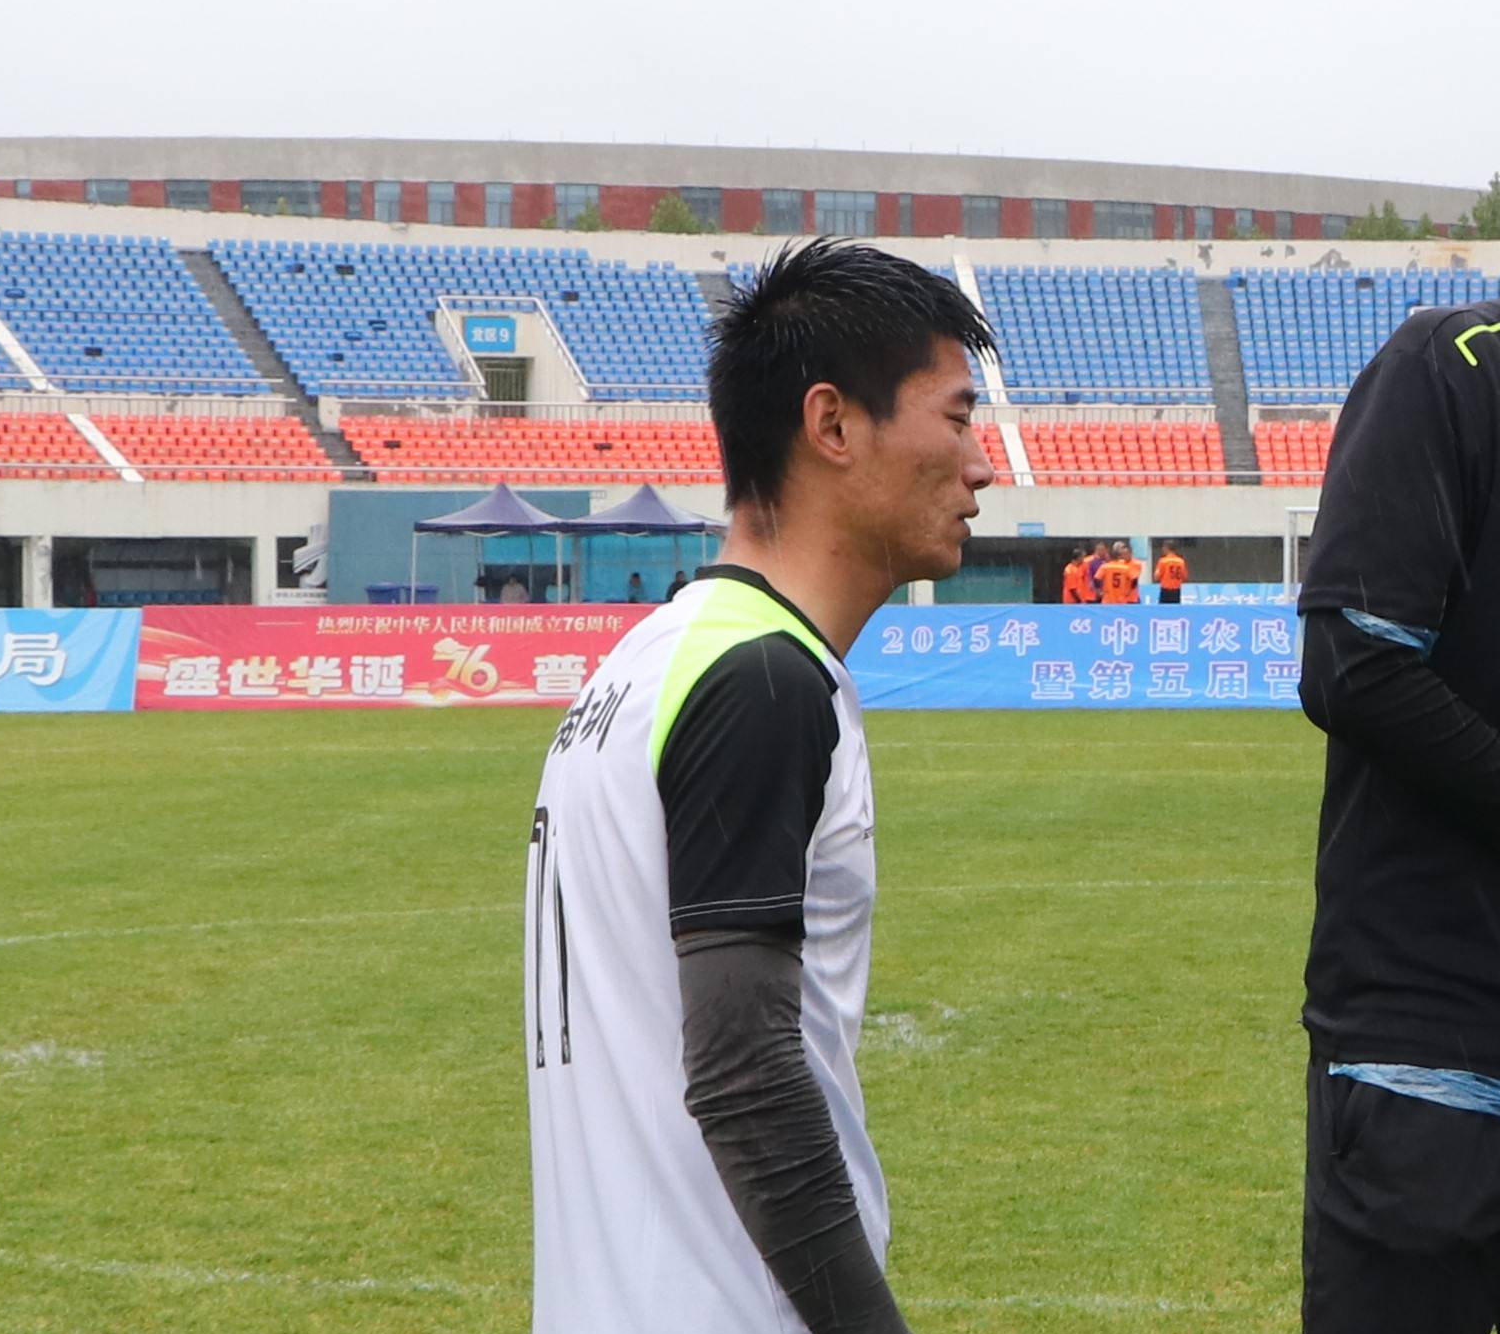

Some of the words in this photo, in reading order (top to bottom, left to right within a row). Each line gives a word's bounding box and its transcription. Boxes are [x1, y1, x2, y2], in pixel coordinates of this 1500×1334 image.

[1111, 572, 1121, 588] 5
[316, 614, 625, 635] 热烈庆祝中华人民共和国成立76周年
[881, 619, 1041, 657] 2025年
[163, 654, 406, 697] 盛世华诞
[533, 653, 609, 696] 普
